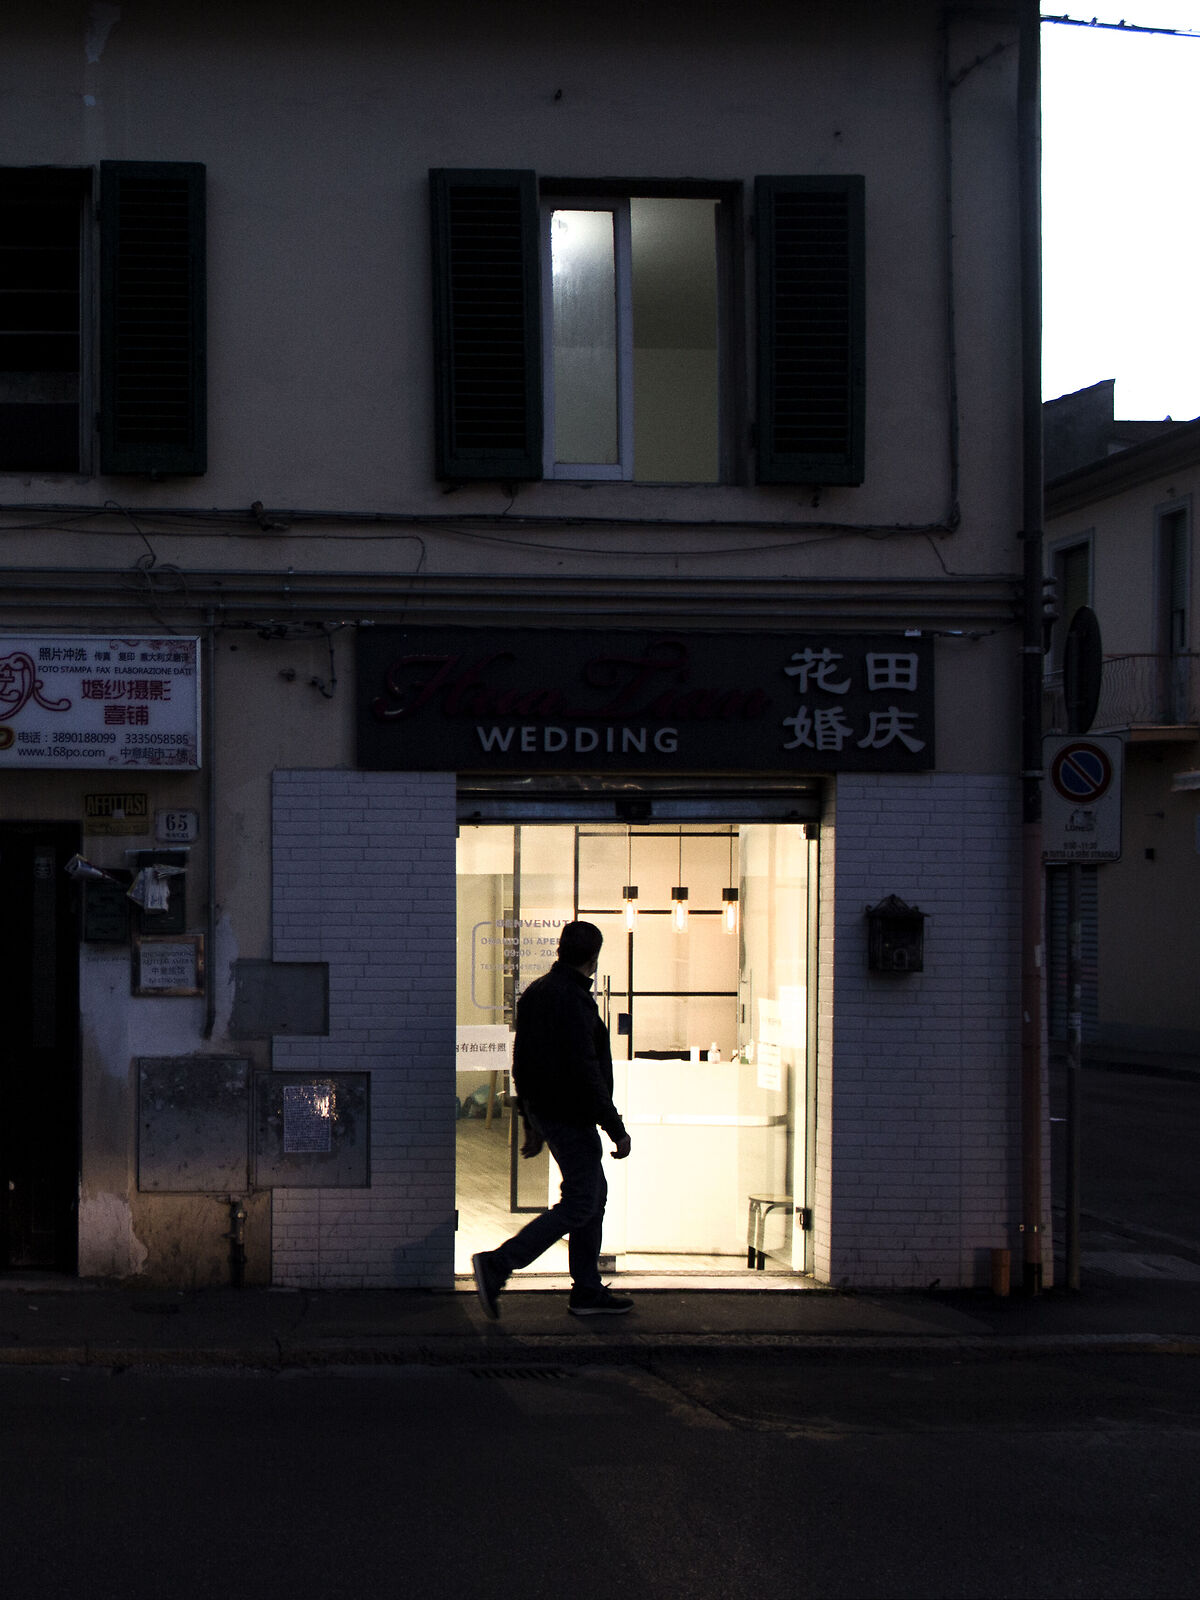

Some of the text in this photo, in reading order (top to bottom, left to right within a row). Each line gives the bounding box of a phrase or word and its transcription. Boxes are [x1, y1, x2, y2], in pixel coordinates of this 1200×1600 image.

[39, 647, 88, 662] 照片冲洗
[37, 665, 60, 674] FOTO
[60, 665, 93, 675] STAMPA
[96, 666, 111, 675] FAX
[114, 666, 173, 676] ELABORAZIONE
[783, 647, 919, 695] 花田
[81, 679, 173, 702] 婚纱摄影
[103, 705, 150, 726] 喜铺
[51, 732, 118, 745] 3890188099
[782, 704, 927, 754] 婚庆
[476, 726, 681, 754] WEDDING
[17, 746, 106, 760] www.168po.com
[166, 814, 188, 832] 65
